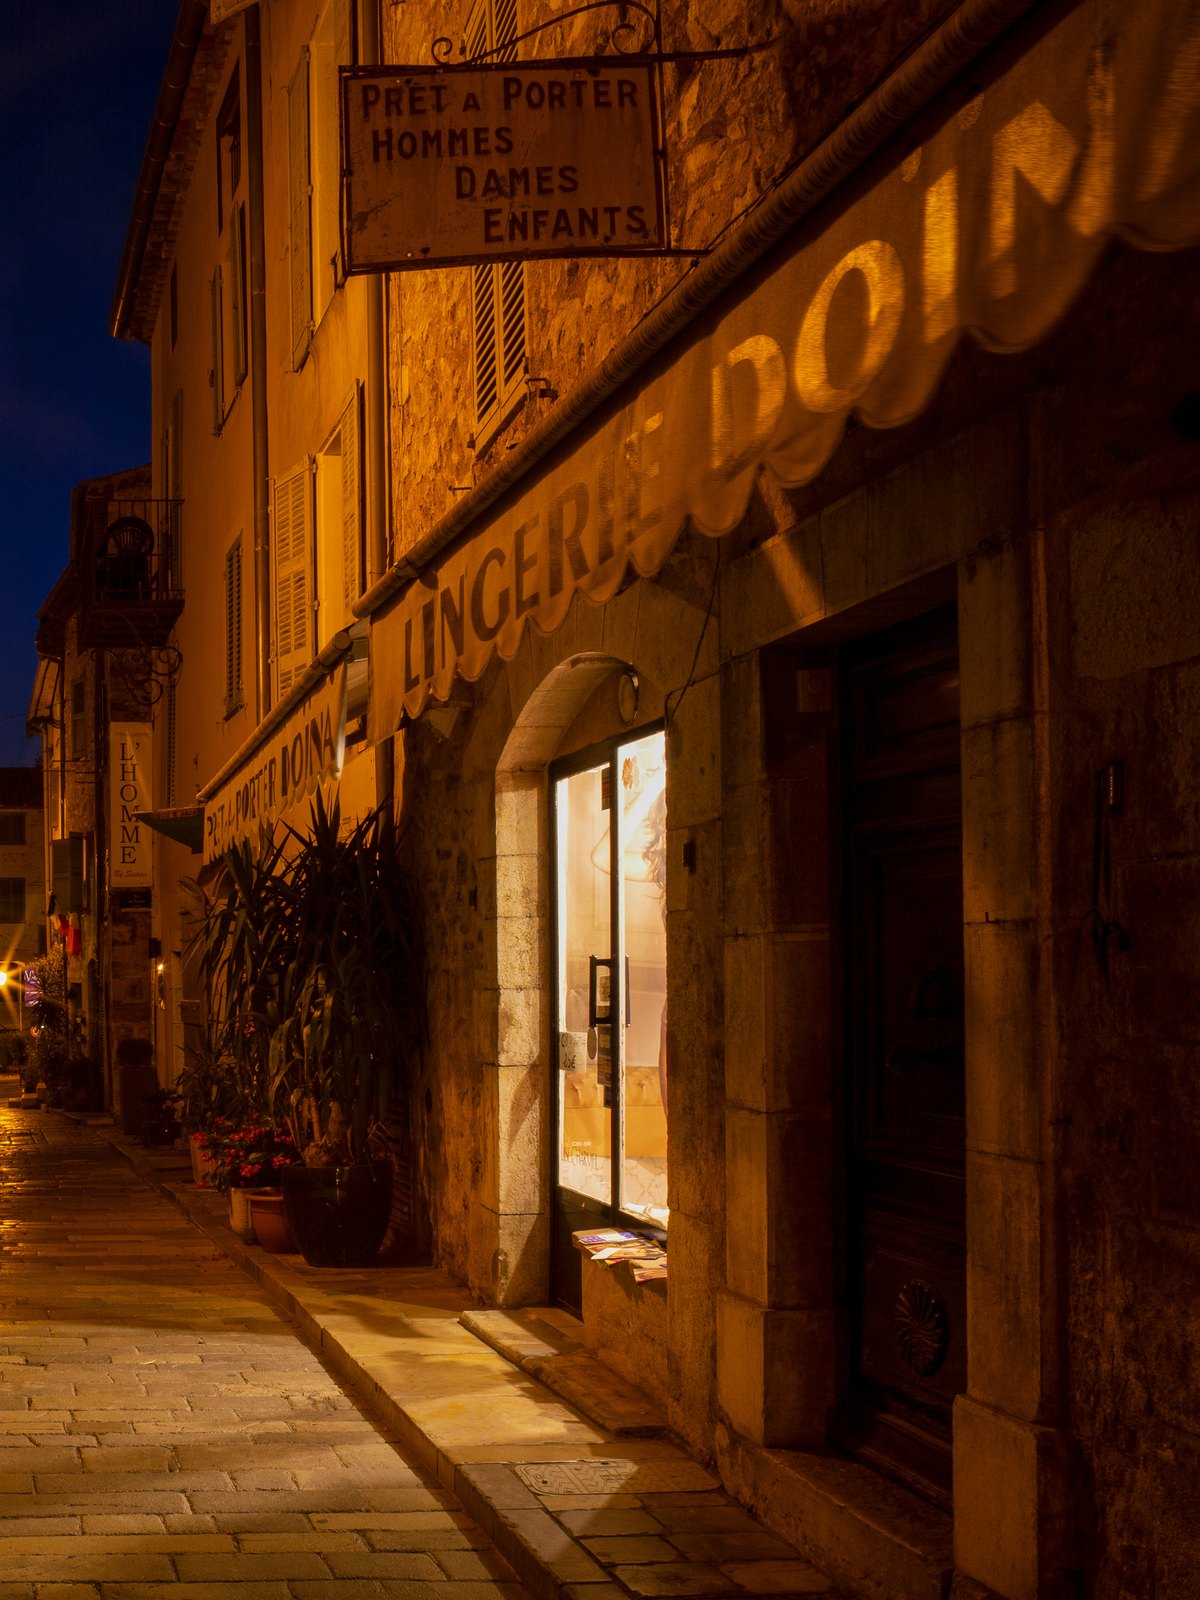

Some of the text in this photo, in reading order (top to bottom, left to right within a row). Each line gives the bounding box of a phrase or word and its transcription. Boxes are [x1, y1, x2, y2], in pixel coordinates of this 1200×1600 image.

[502, 77, 639, 111] PORTER
[371, 126, 514, 162] HOMMES
[455, 165, 579, 199] DAMES
[483, 205, 647, 243] ENFANTS
[403, 407, 665, 692] LINGERIE
